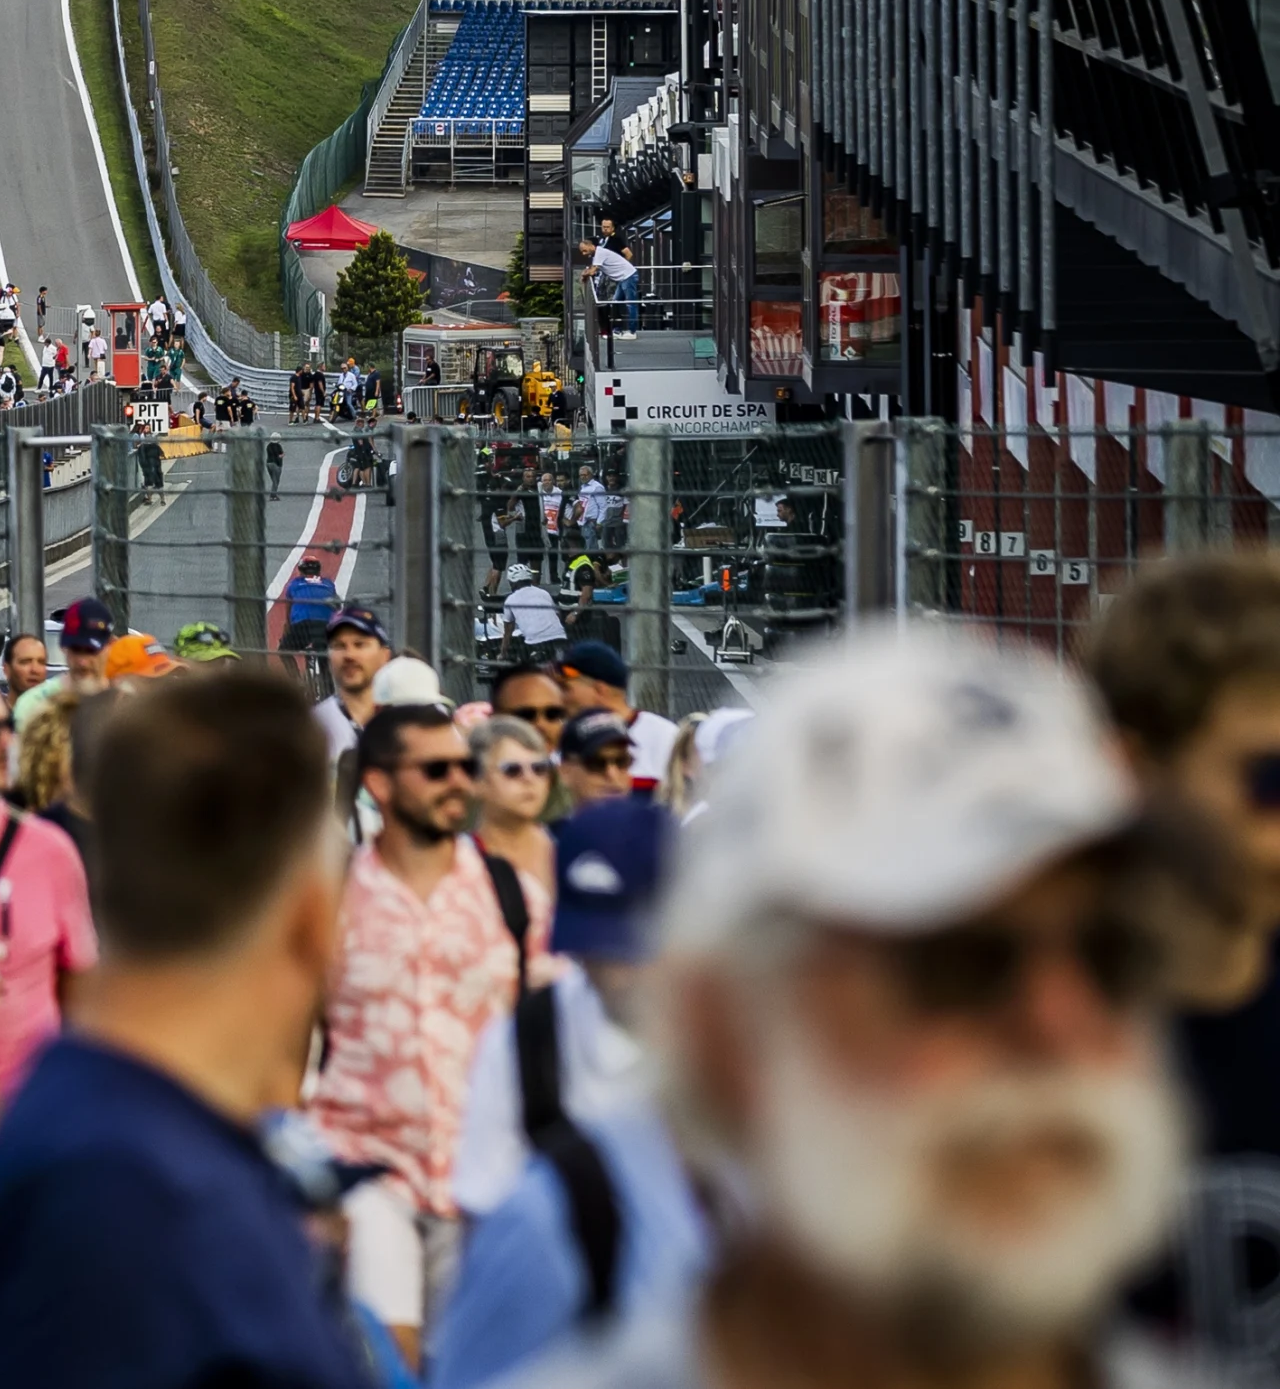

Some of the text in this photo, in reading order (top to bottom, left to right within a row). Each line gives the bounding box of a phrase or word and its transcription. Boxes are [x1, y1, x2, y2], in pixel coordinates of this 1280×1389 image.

[139, 404, 160, 417] PIT
[647, 404, 767, 419] CIRCUIT DE SPA
[980, 533, 990, 553] 8
[1008, 536, 1018, 553] 7
[1069, 563, 1081, 581] 5
